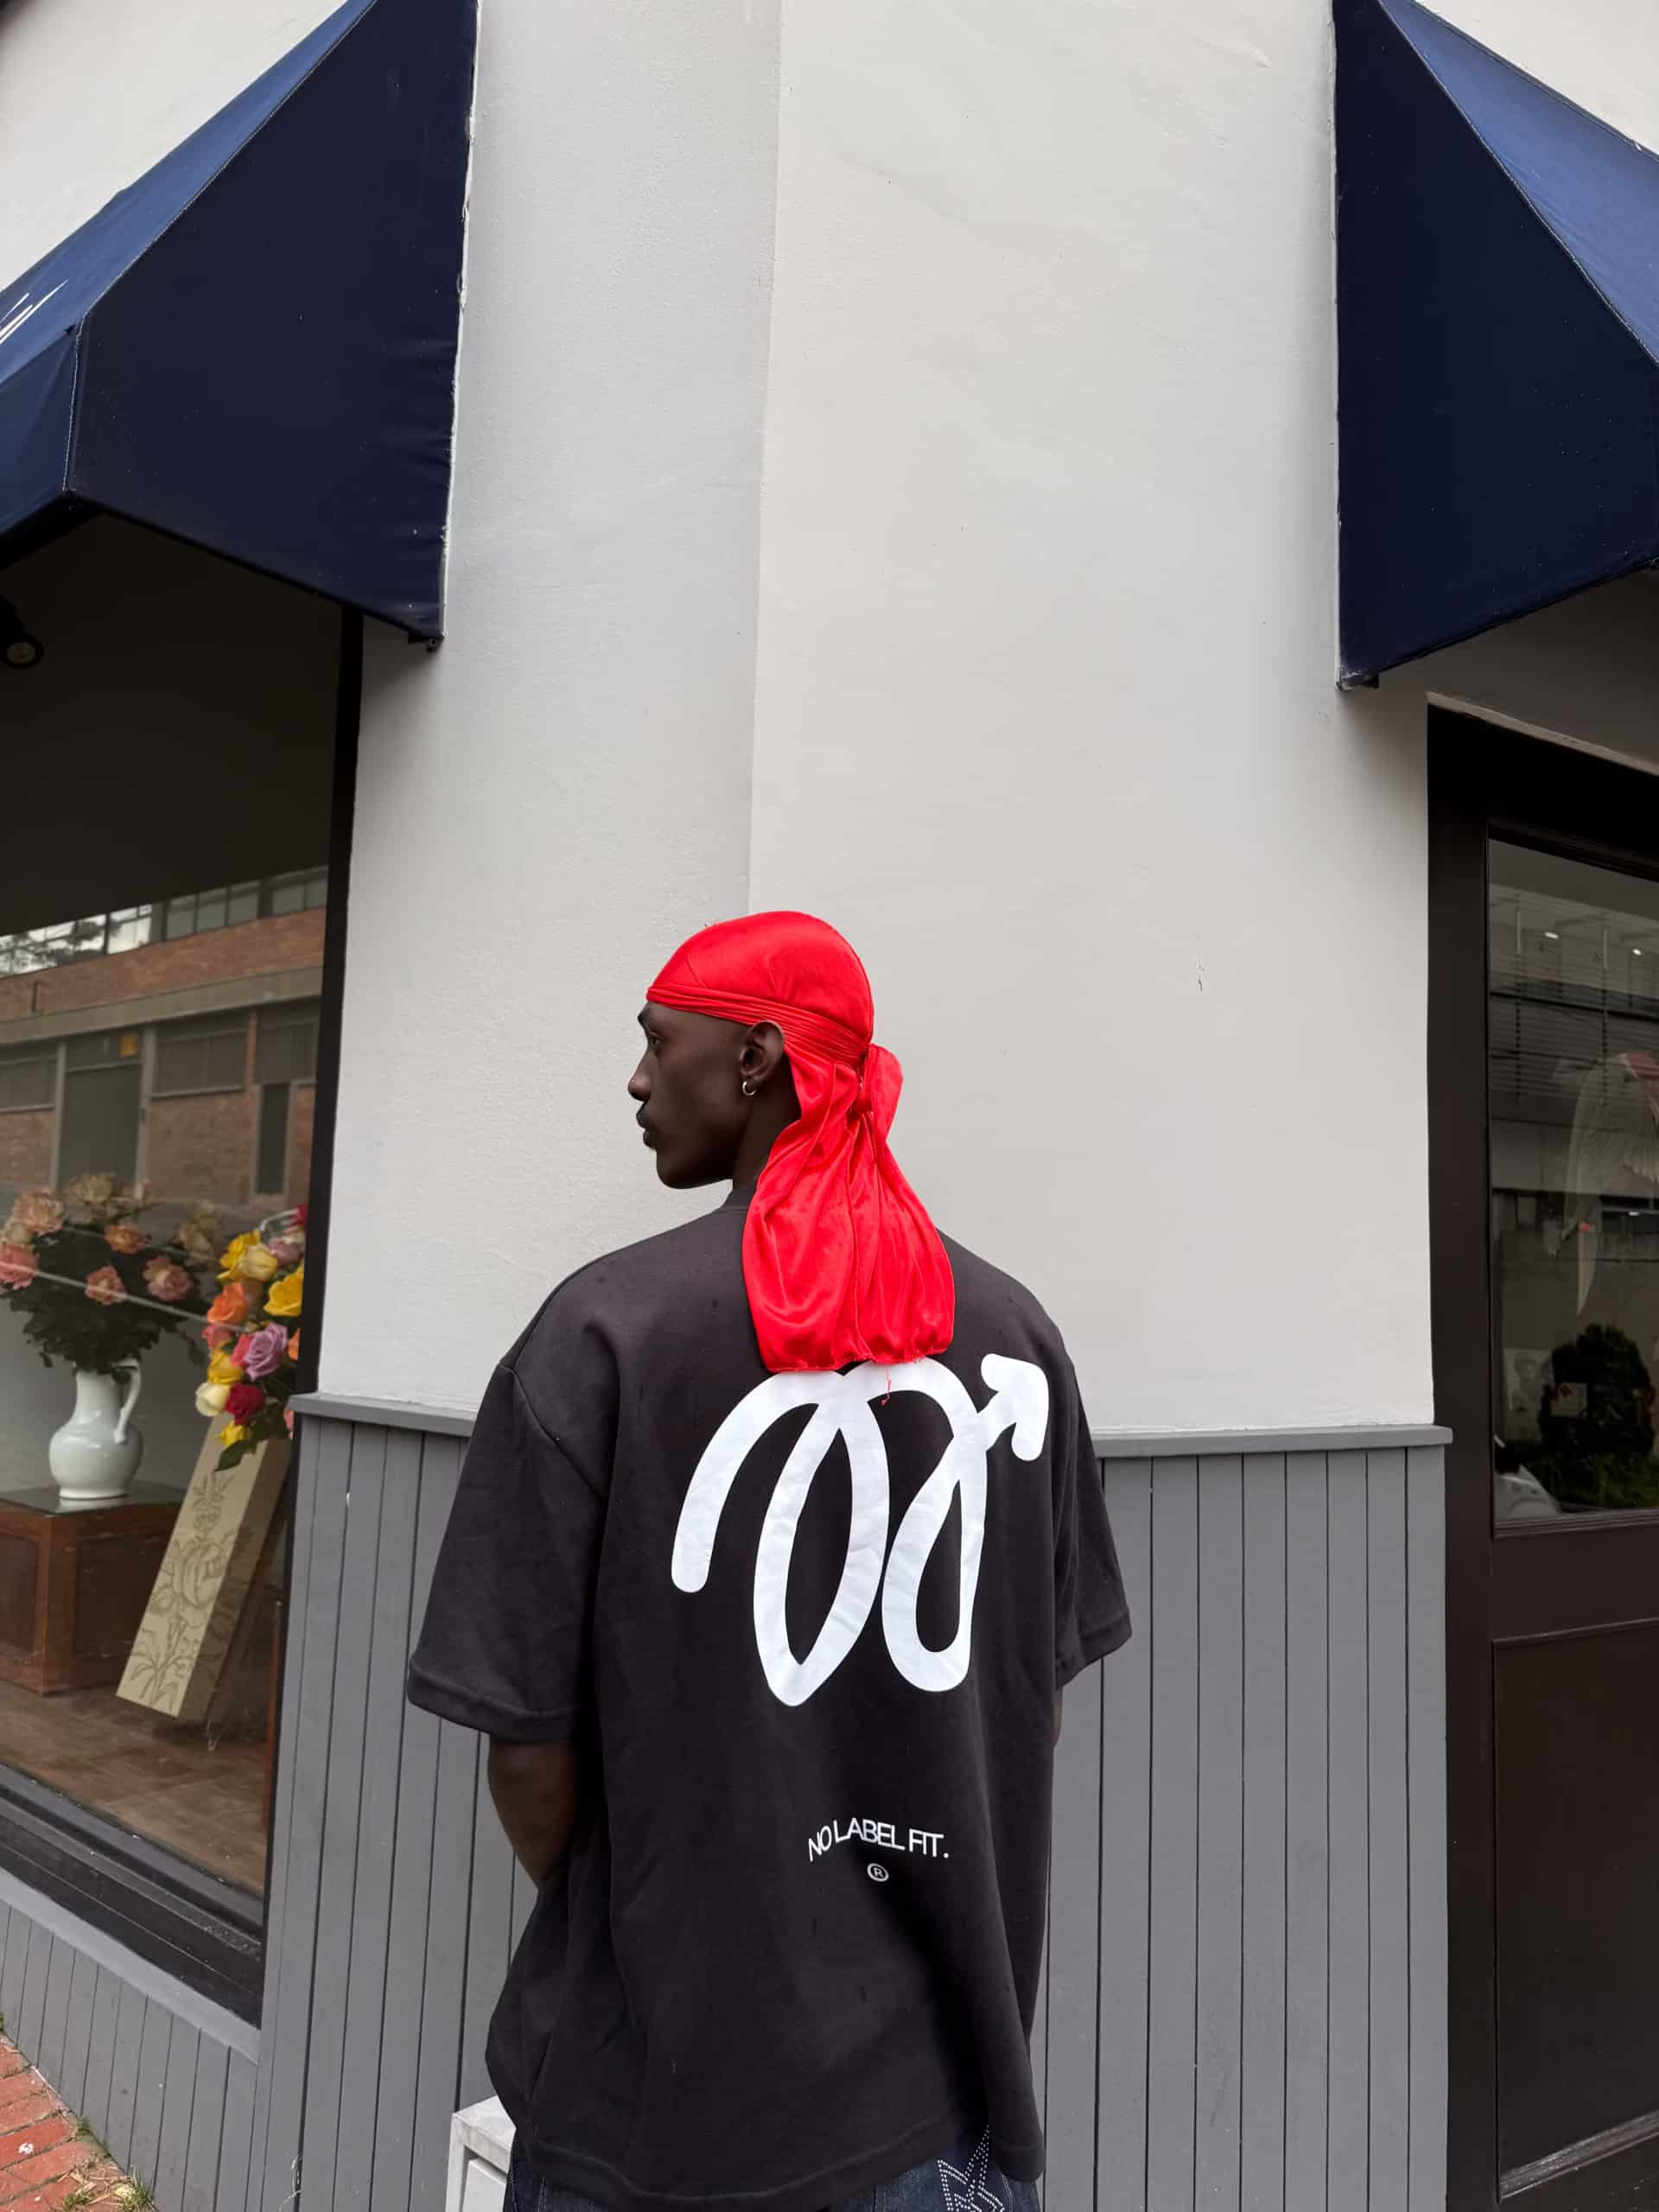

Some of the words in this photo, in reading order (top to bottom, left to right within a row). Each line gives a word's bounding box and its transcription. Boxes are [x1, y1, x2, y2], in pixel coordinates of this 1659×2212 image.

[809, 1825, 832, 1862] NO
[833, 1817, 906, 1851] LABEL
[909, 1828, 950, 1859] FIT.
